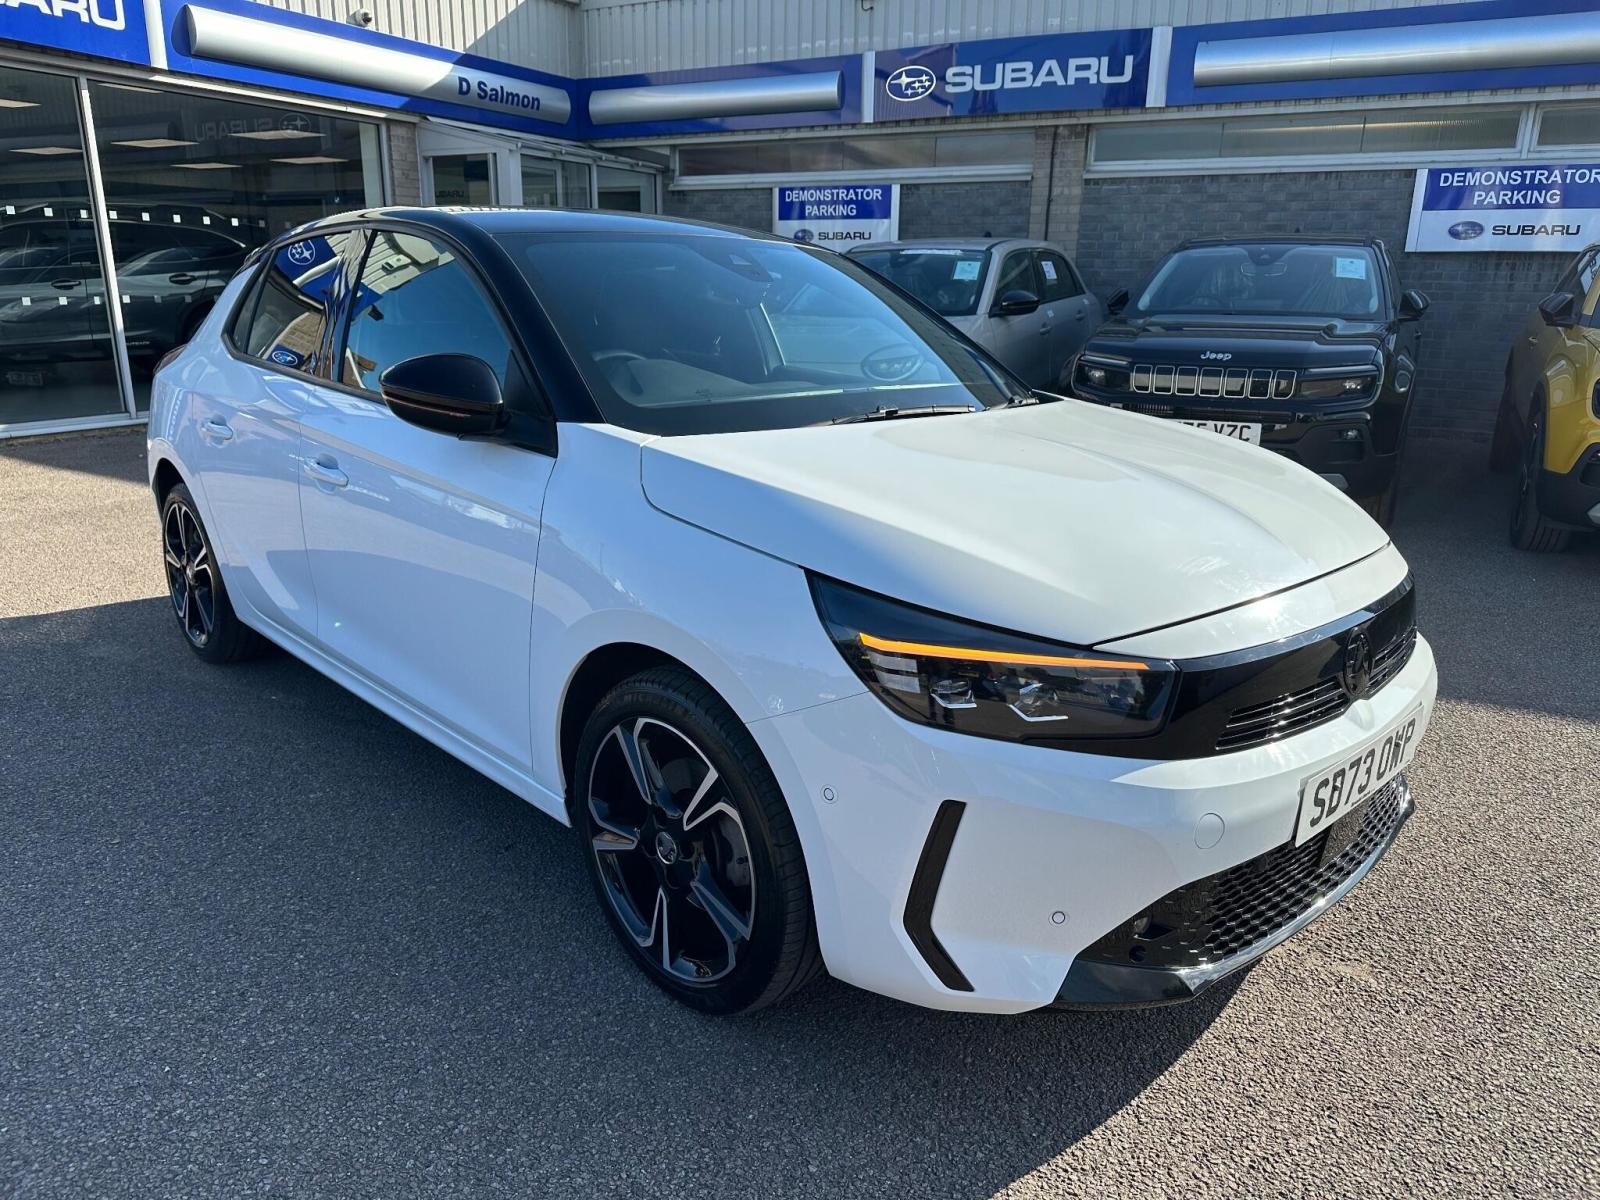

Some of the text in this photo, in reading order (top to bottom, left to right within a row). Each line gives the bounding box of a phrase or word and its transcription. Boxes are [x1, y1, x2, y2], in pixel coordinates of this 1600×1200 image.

[0, 0, 125, 31] RU
[944, 54, 1134, 94] SUBARU
[457, 76, 541, 111] D Salmon
[1439, 169, 1600, 187] DEMONSTRATOR
[785, 188, 882, 202] DEMONSTRATOR
[1473, 190, 1561, 206] PARKING
[805, 204, 857, 217] PARKING
[818, 231, 872, 241] SUBARU
[1491, 224, 1581, 236] SUBARU
[1200, 350, 1232, 361] Jeep
[1376, 717, 1416, 782] OWP
